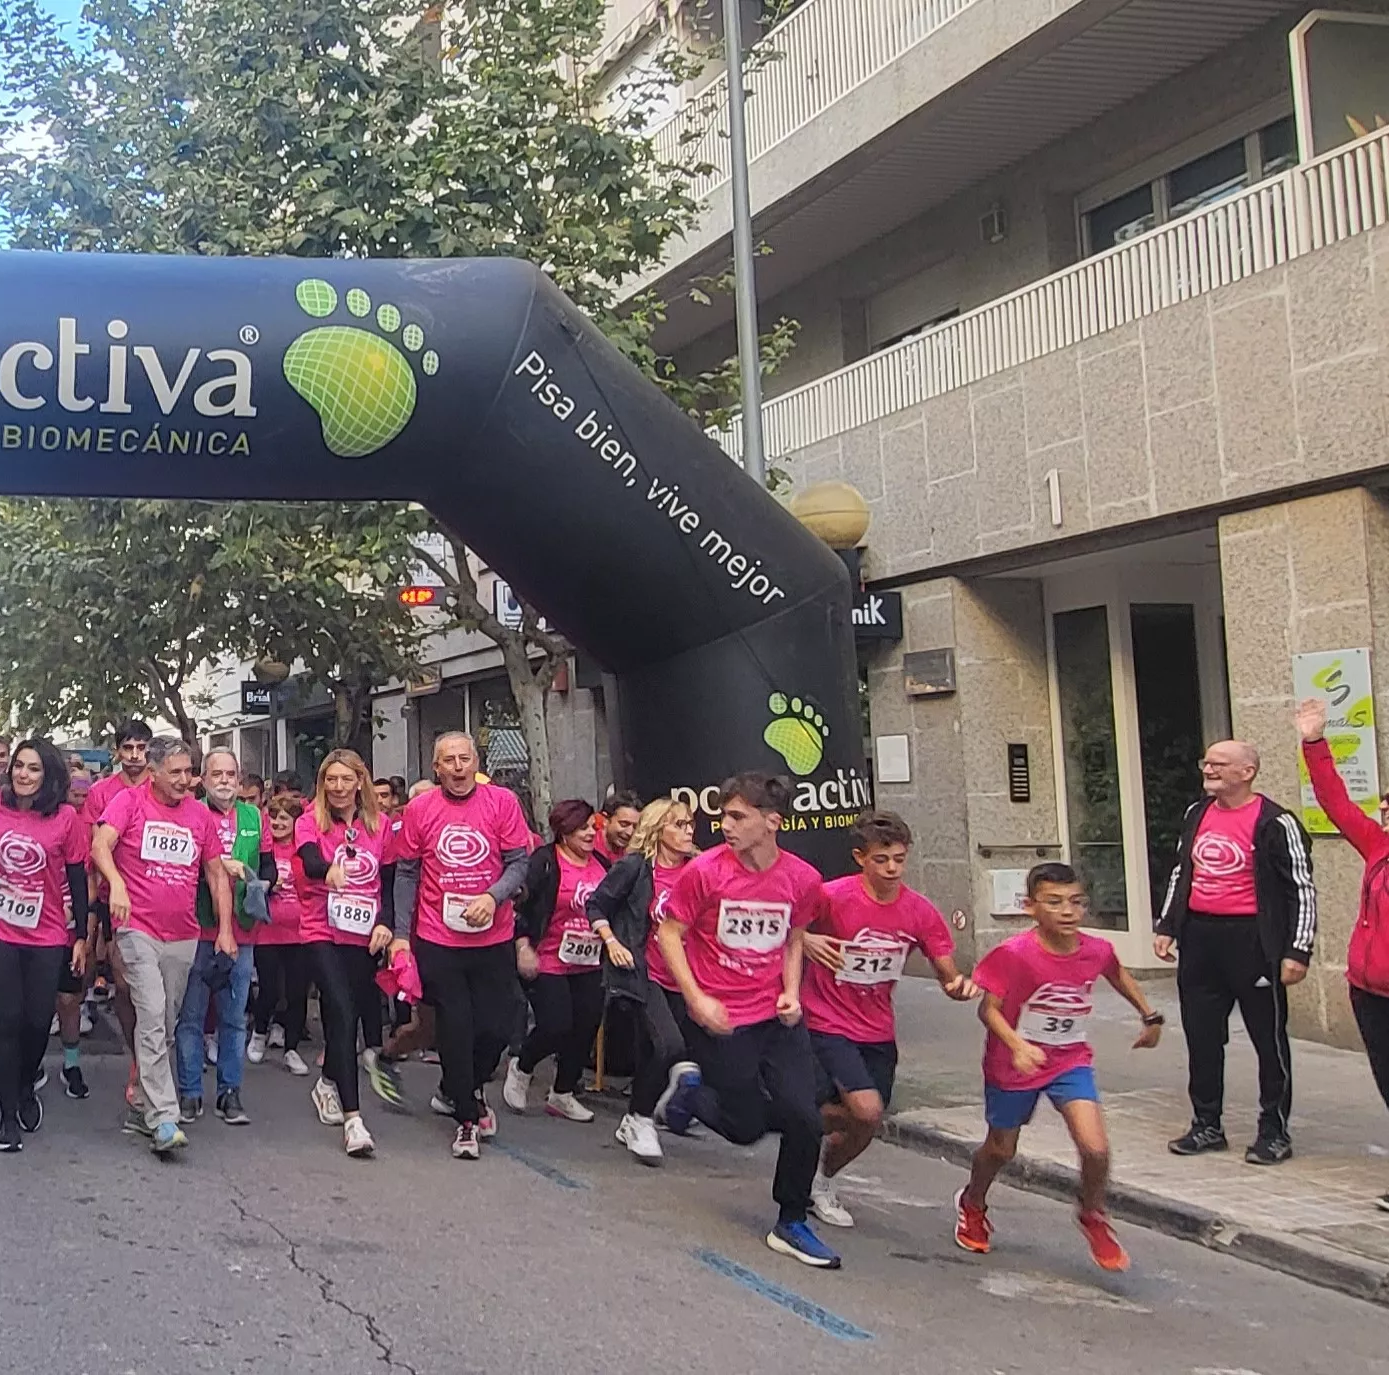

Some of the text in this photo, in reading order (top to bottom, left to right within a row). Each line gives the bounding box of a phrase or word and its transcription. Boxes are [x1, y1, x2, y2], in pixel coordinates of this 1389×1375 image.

[2, 422, 251, 456] BIOMECÁNICA
[515, 350, 785, 605] Pisa bien, vive mejor
[149, 835, 188, 853] 1887
[334, 904, 371, 923] 1889
[726, 918, 781, 935] 2815
[565, 942, 598, 956] 2801
[852, 957, 892, 973] 212
[1043, 1017, 1074, 1033] 39
